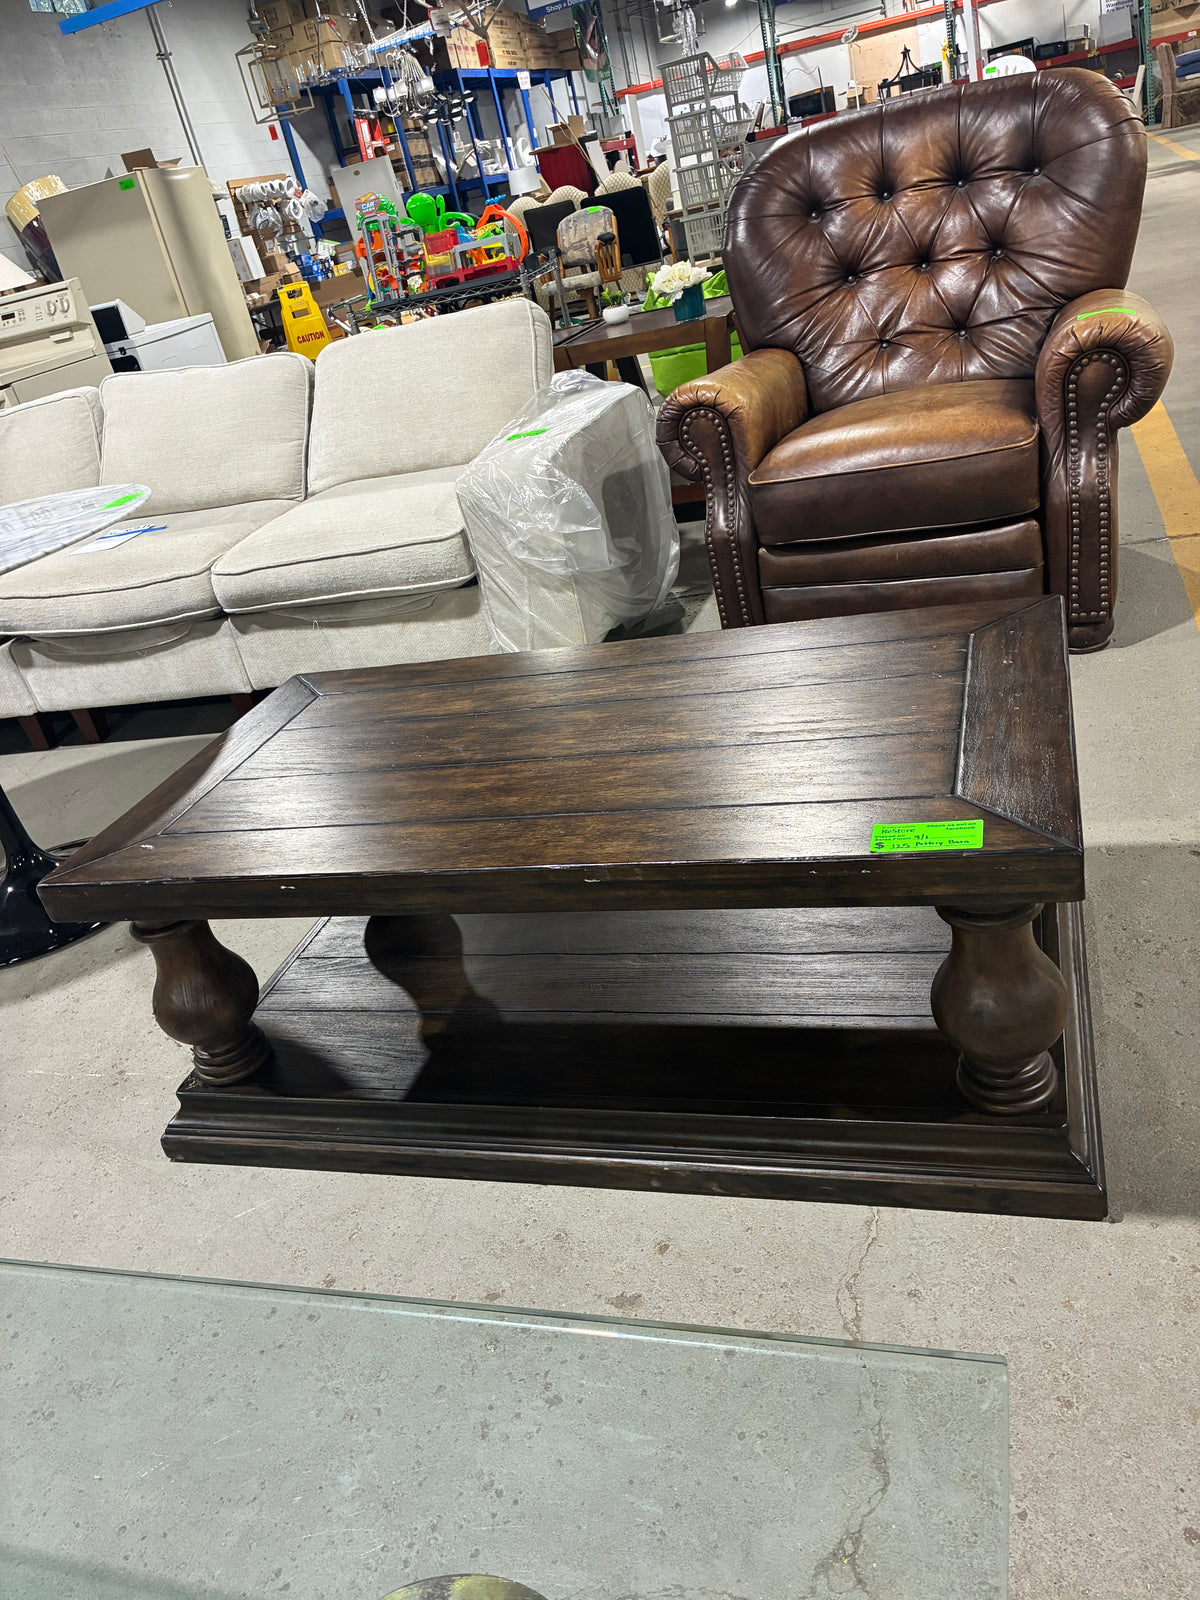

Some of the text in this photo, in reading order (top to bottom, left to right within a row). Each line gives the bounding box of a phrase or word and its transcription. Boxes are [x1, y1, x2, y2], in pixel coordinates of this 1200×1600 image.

[546, 4, 562, 12] Shop
[362, 201, 375, 210] CAR
[296, 330, 326, 345] CAUTION
[873, 841, 885, 850] $
